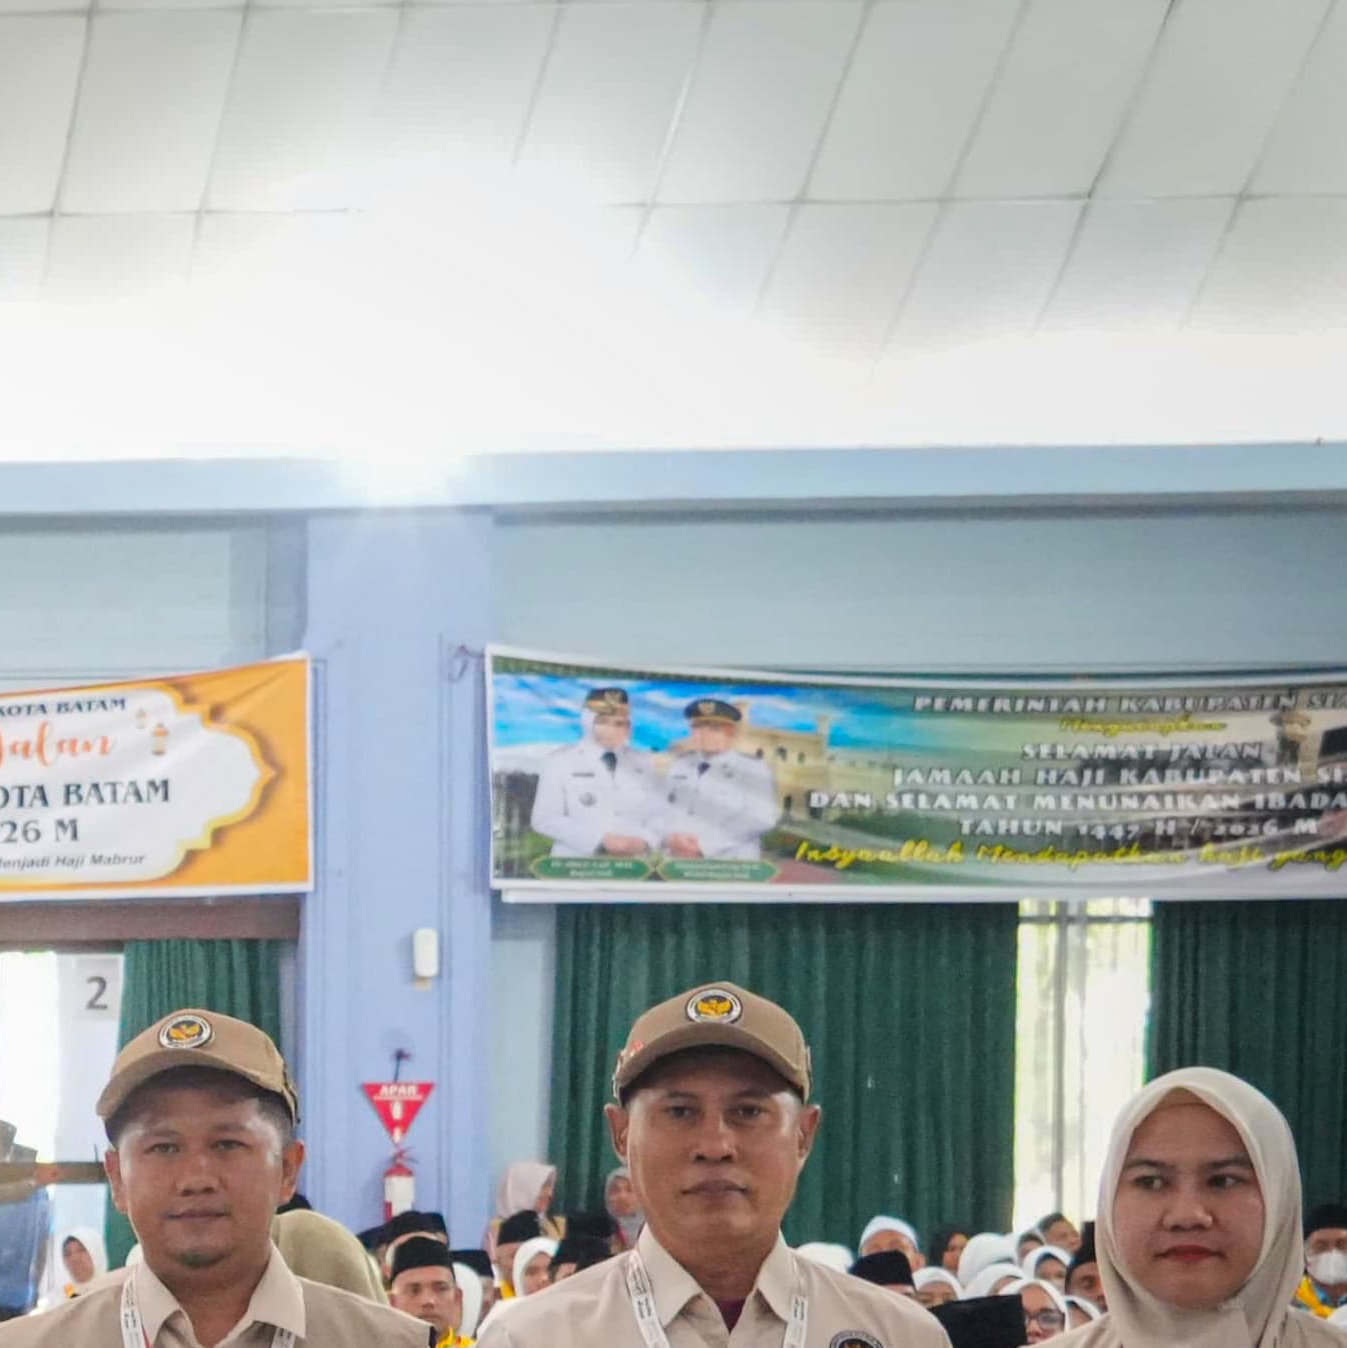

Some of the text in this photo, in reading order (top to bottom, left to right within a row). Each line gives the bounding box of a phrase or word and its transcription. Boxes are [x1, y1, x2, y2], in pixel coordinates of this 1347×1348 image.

[56, 697, 128, 714] BATAM
[914, 696, 1107, 713] PEMERINTAH
[1119, 695, 1296, 712] KABUPATEN
[1022, 742, 1263, 760] SELAMAT JALAN
[894, 766, 1347, 788] JAMAAH HAJI KABUPATEN SI
[63, 778, 171, 805] BATAM
[809, 791, 872, 809] DAN
[886, 792, 1018, 810] SELAMAT
[1033, 792, 1242, 810] MENUNAIKAN
[54, 818, 80, 842] M
[960, 818, 1063, 835] TAHUN
[1078, 823, 1142, 841] 1447
[1156, 819, 1177, 835] H
[1293, 817, 1320, 835] M
[55, 854, 86, 870] Haji
[90, 852, 147, 867] Mabrur
[86, 975, 108, 1010] 2
[379, 1085, 418, 1096] APAR
